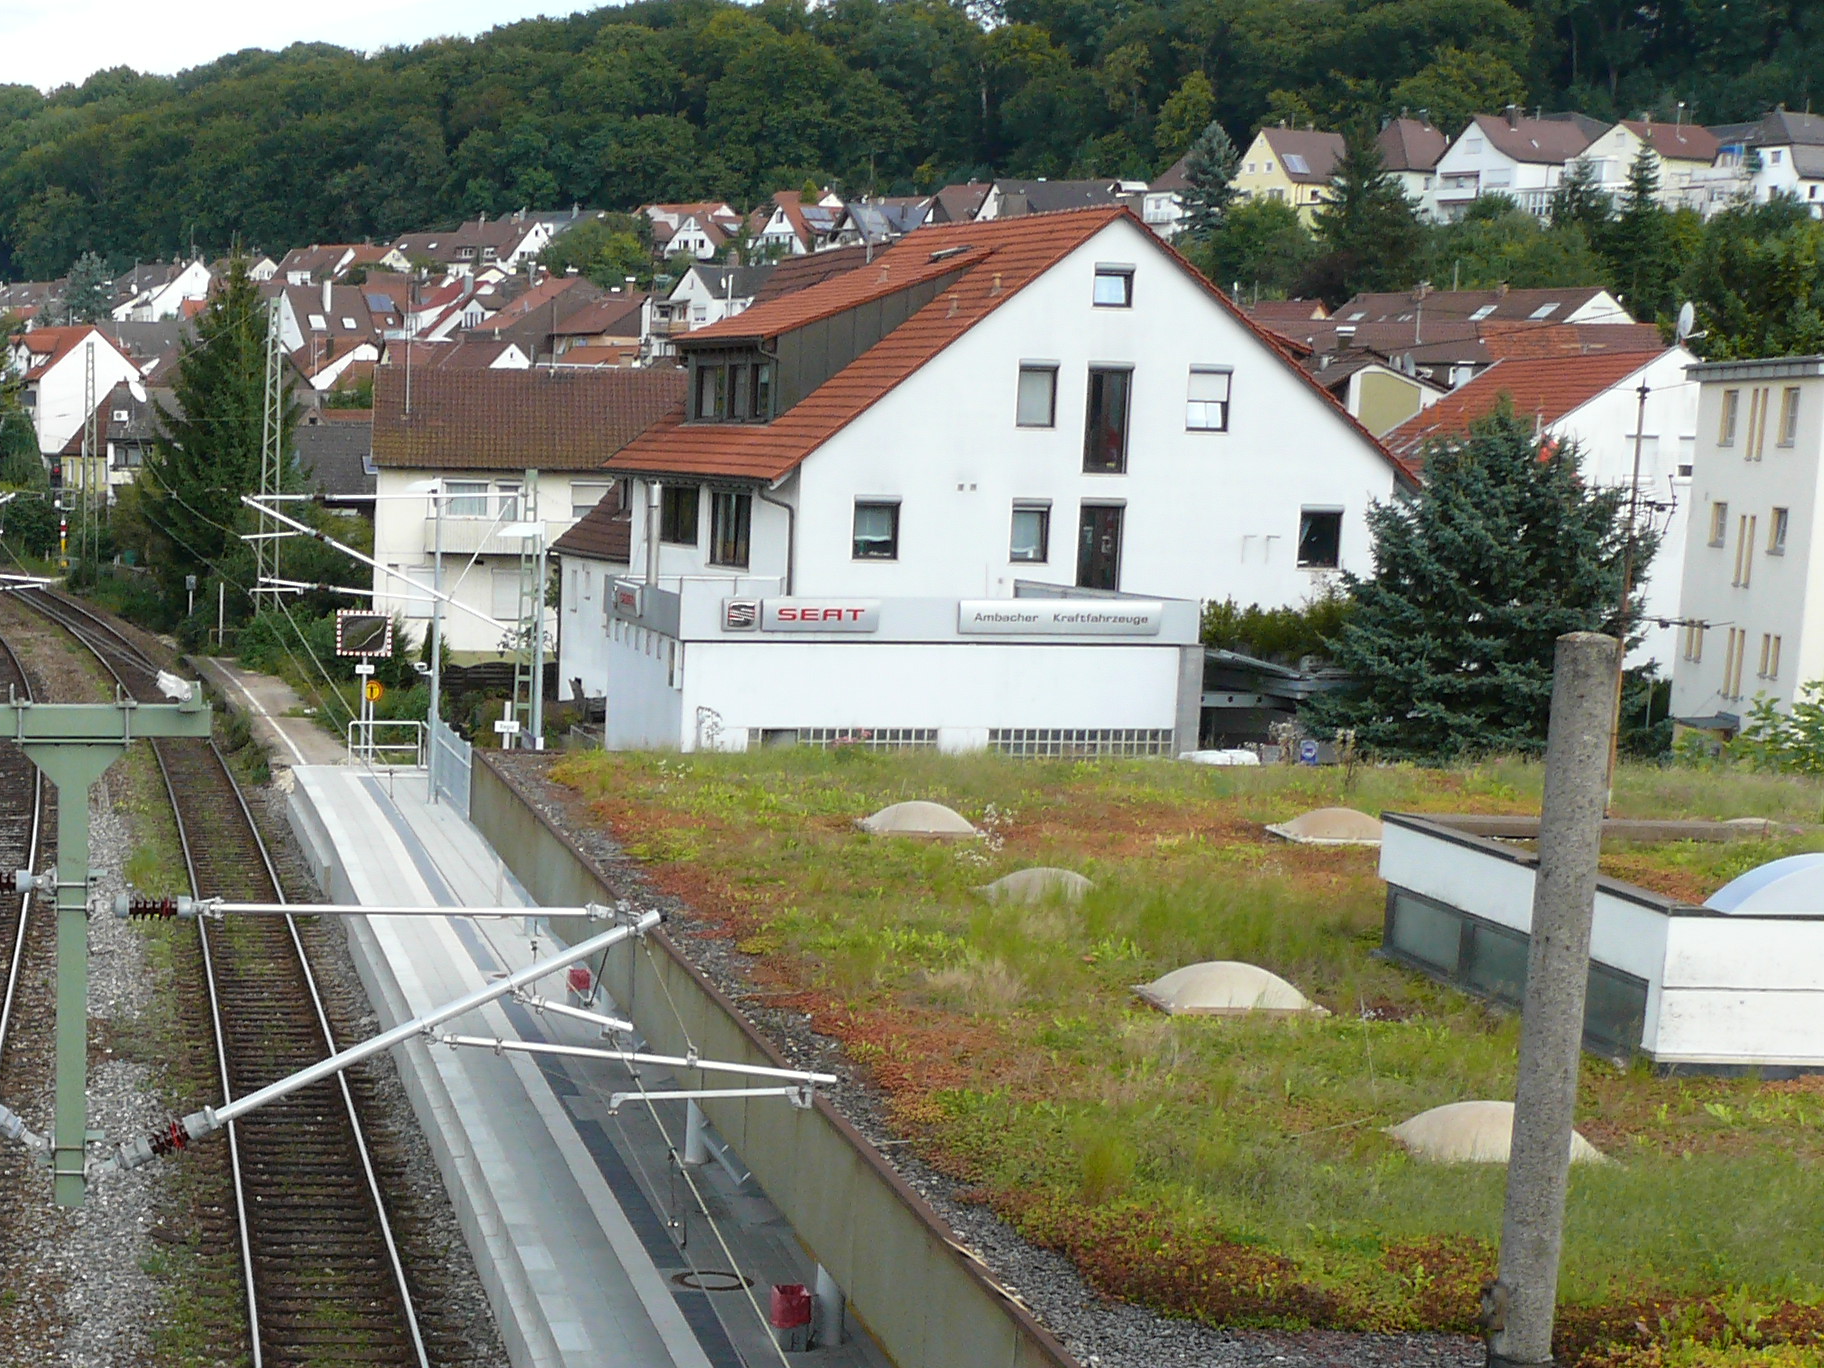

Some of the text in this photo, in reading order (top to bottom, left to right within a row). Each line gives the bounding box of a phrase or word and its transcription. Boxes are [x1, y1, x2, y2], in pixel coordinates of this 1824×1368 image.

[777, 608, 865, 621] SEAT
[974, 612, 1149, 626] Ambacher Kraftfahrzeuge
